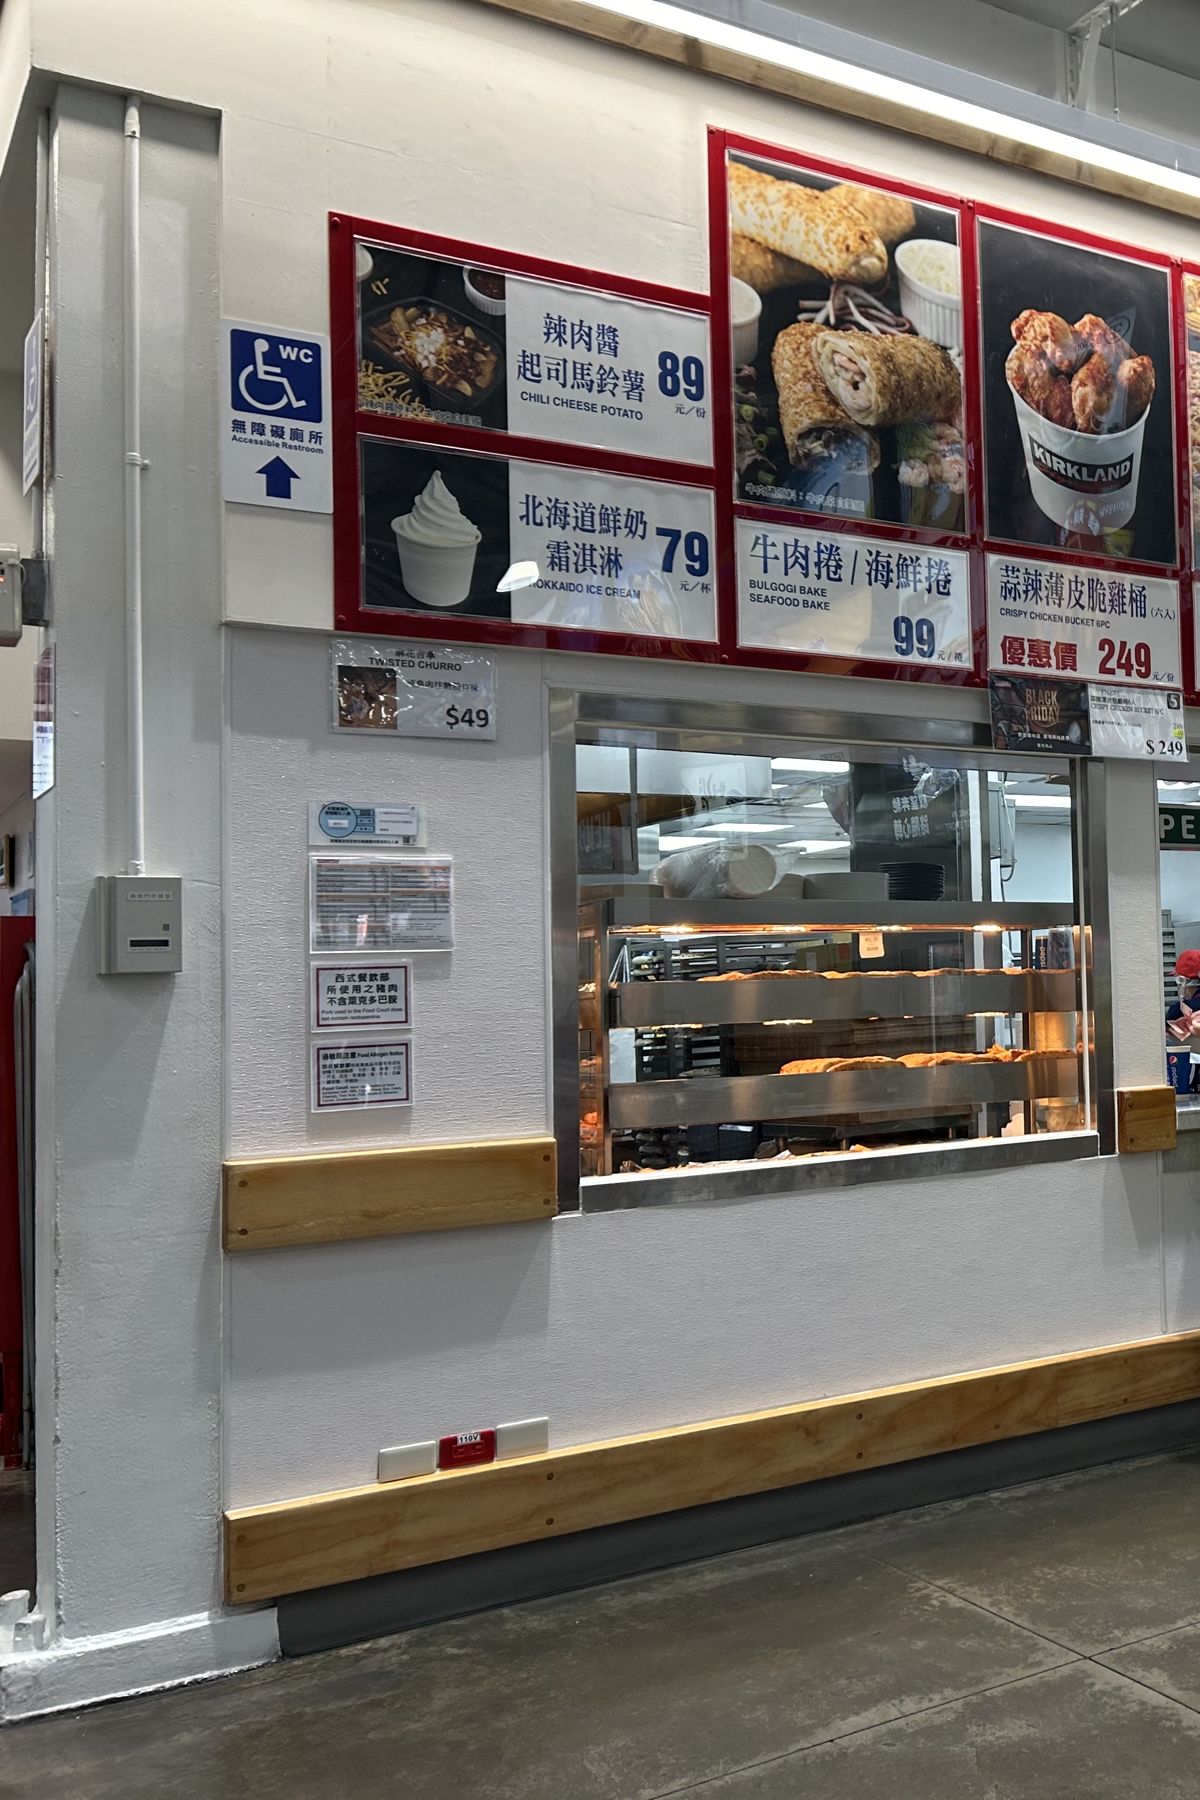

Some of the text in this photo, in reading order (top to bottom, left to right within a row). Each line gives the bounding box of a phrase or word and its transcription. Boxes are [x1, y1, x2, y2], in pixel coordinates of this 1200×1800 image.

[543, 313, 620, 358] 辣肉醬
[278, 344, 314, 363] WC
[517, 350, 645, 402] 起司馬鈴薯
[658, 351, 705, 401] 89
[520, 391, 643, 421] CHILI CHEESE POTATO
[231, 419, 323, 445] 無障礙廁所
[231, 434, 324, 454] Accessible Restroom
[1032, 442, 1131, 481] KIRKLAND
[518, 494, 648, 540] 北海道鮮奶
[546, 539, 623, 578] 霜淇淋
[655, 527, 709, 577] 79
[586, 585, 603, 595] ICE
[605, 587, 640, 599] CREAM
[749, 579, 827, 597] BULGOGI BAKE
[1000, 564, 1147, 619] 蒜辣薄皮脆雞桶
[749, 593, 830, 610] SEAFOOD BAKE
[1000, 607, 1110, 628] CRISPY CHICKEN BUCKET 6PC
[893, 615, 936, 659] 99
[369, 657, 462, 671] TWISTED CHURRO
[1000, 635, 1077, 672] 優惠價
[1098, 638, 1152, 679] 249
[1025, 688, 1057, 707] BLACK
[446, 704, 490, 729] $49
[327, 984, 398, 995] 所使用之豬肉
[327, 995, 398, 1006] 不含萊克多巴胺
[459, 1434, 479, 1443] 110V
